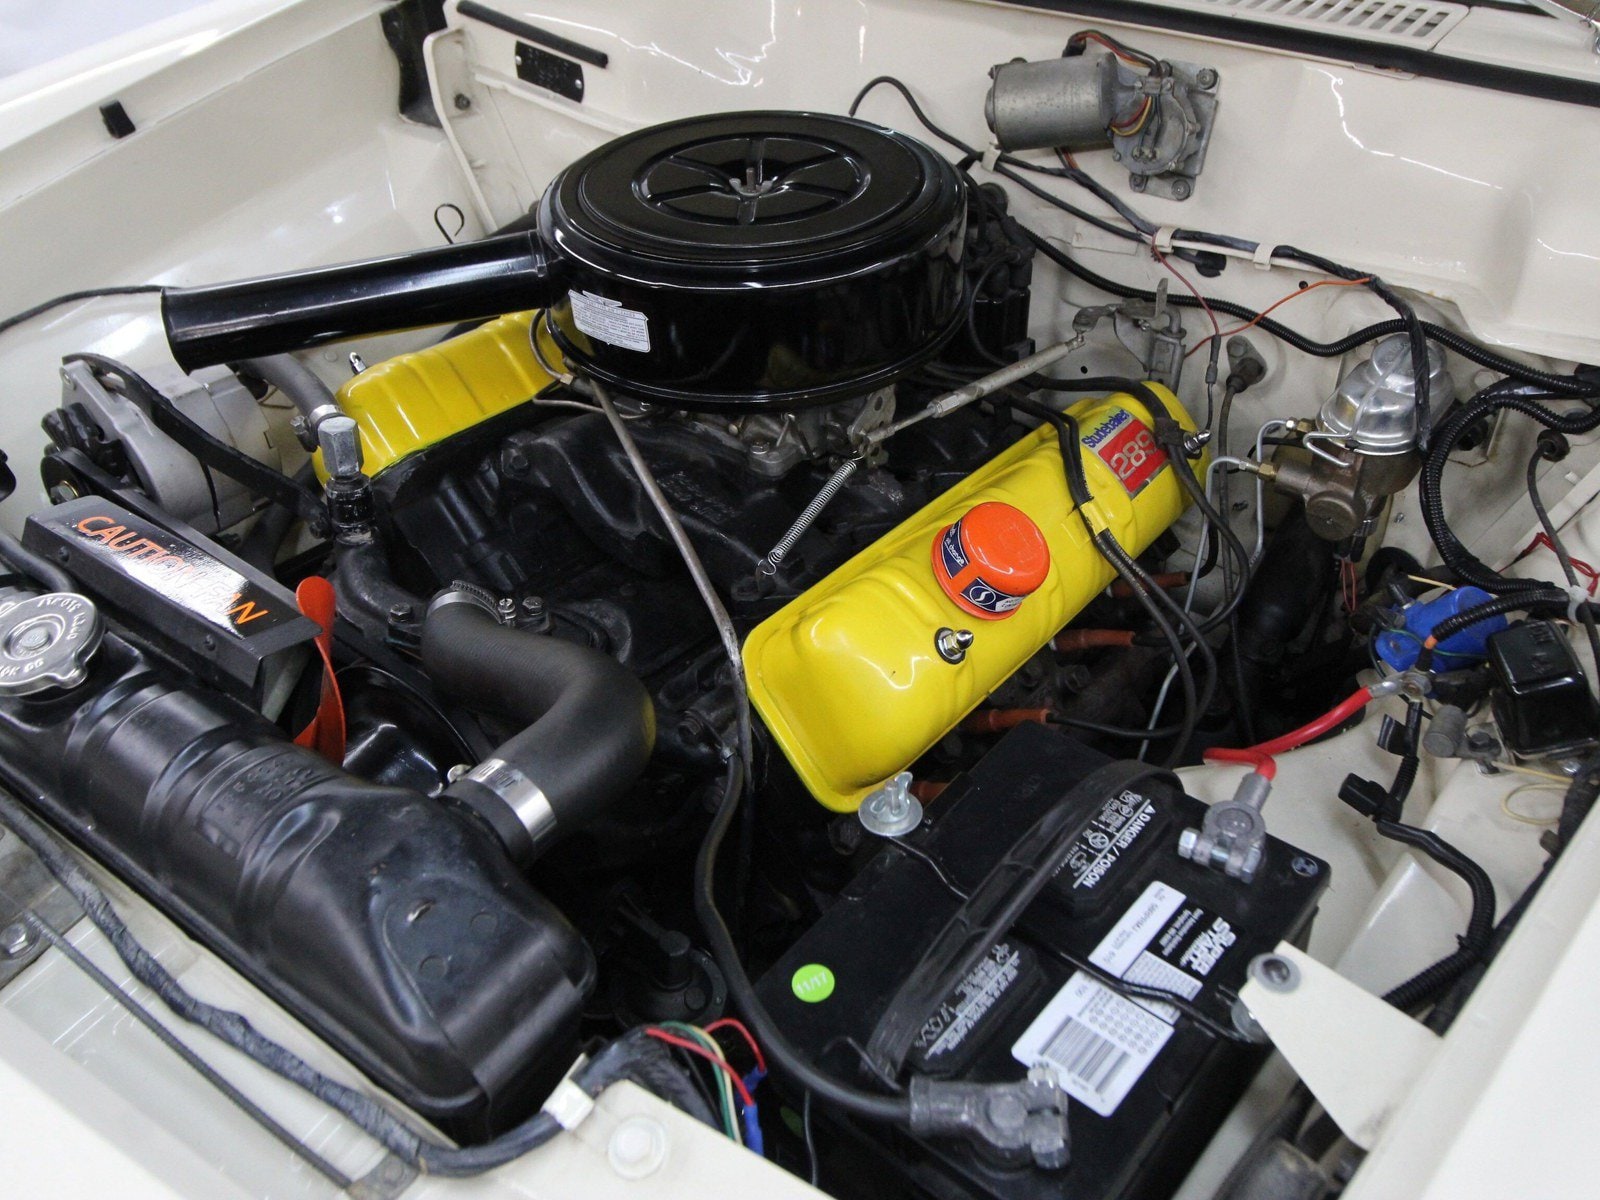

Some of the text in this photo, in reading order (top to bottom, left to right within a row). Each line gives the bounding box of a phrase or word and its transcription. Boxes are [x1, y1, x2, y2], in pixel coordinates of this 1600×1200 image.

[1081, 409, 1131, 448] Studebaker
[1110, 430, 1157, 479] 289
[77, 516, 205, 589] CAUTION
[1116, 812, 1151, 849] DANGER
[1082, 853, 1117, 889] POISON
[1191, 916, 1231, 970] START
[1198, 931, 1237, 976] SUPER
